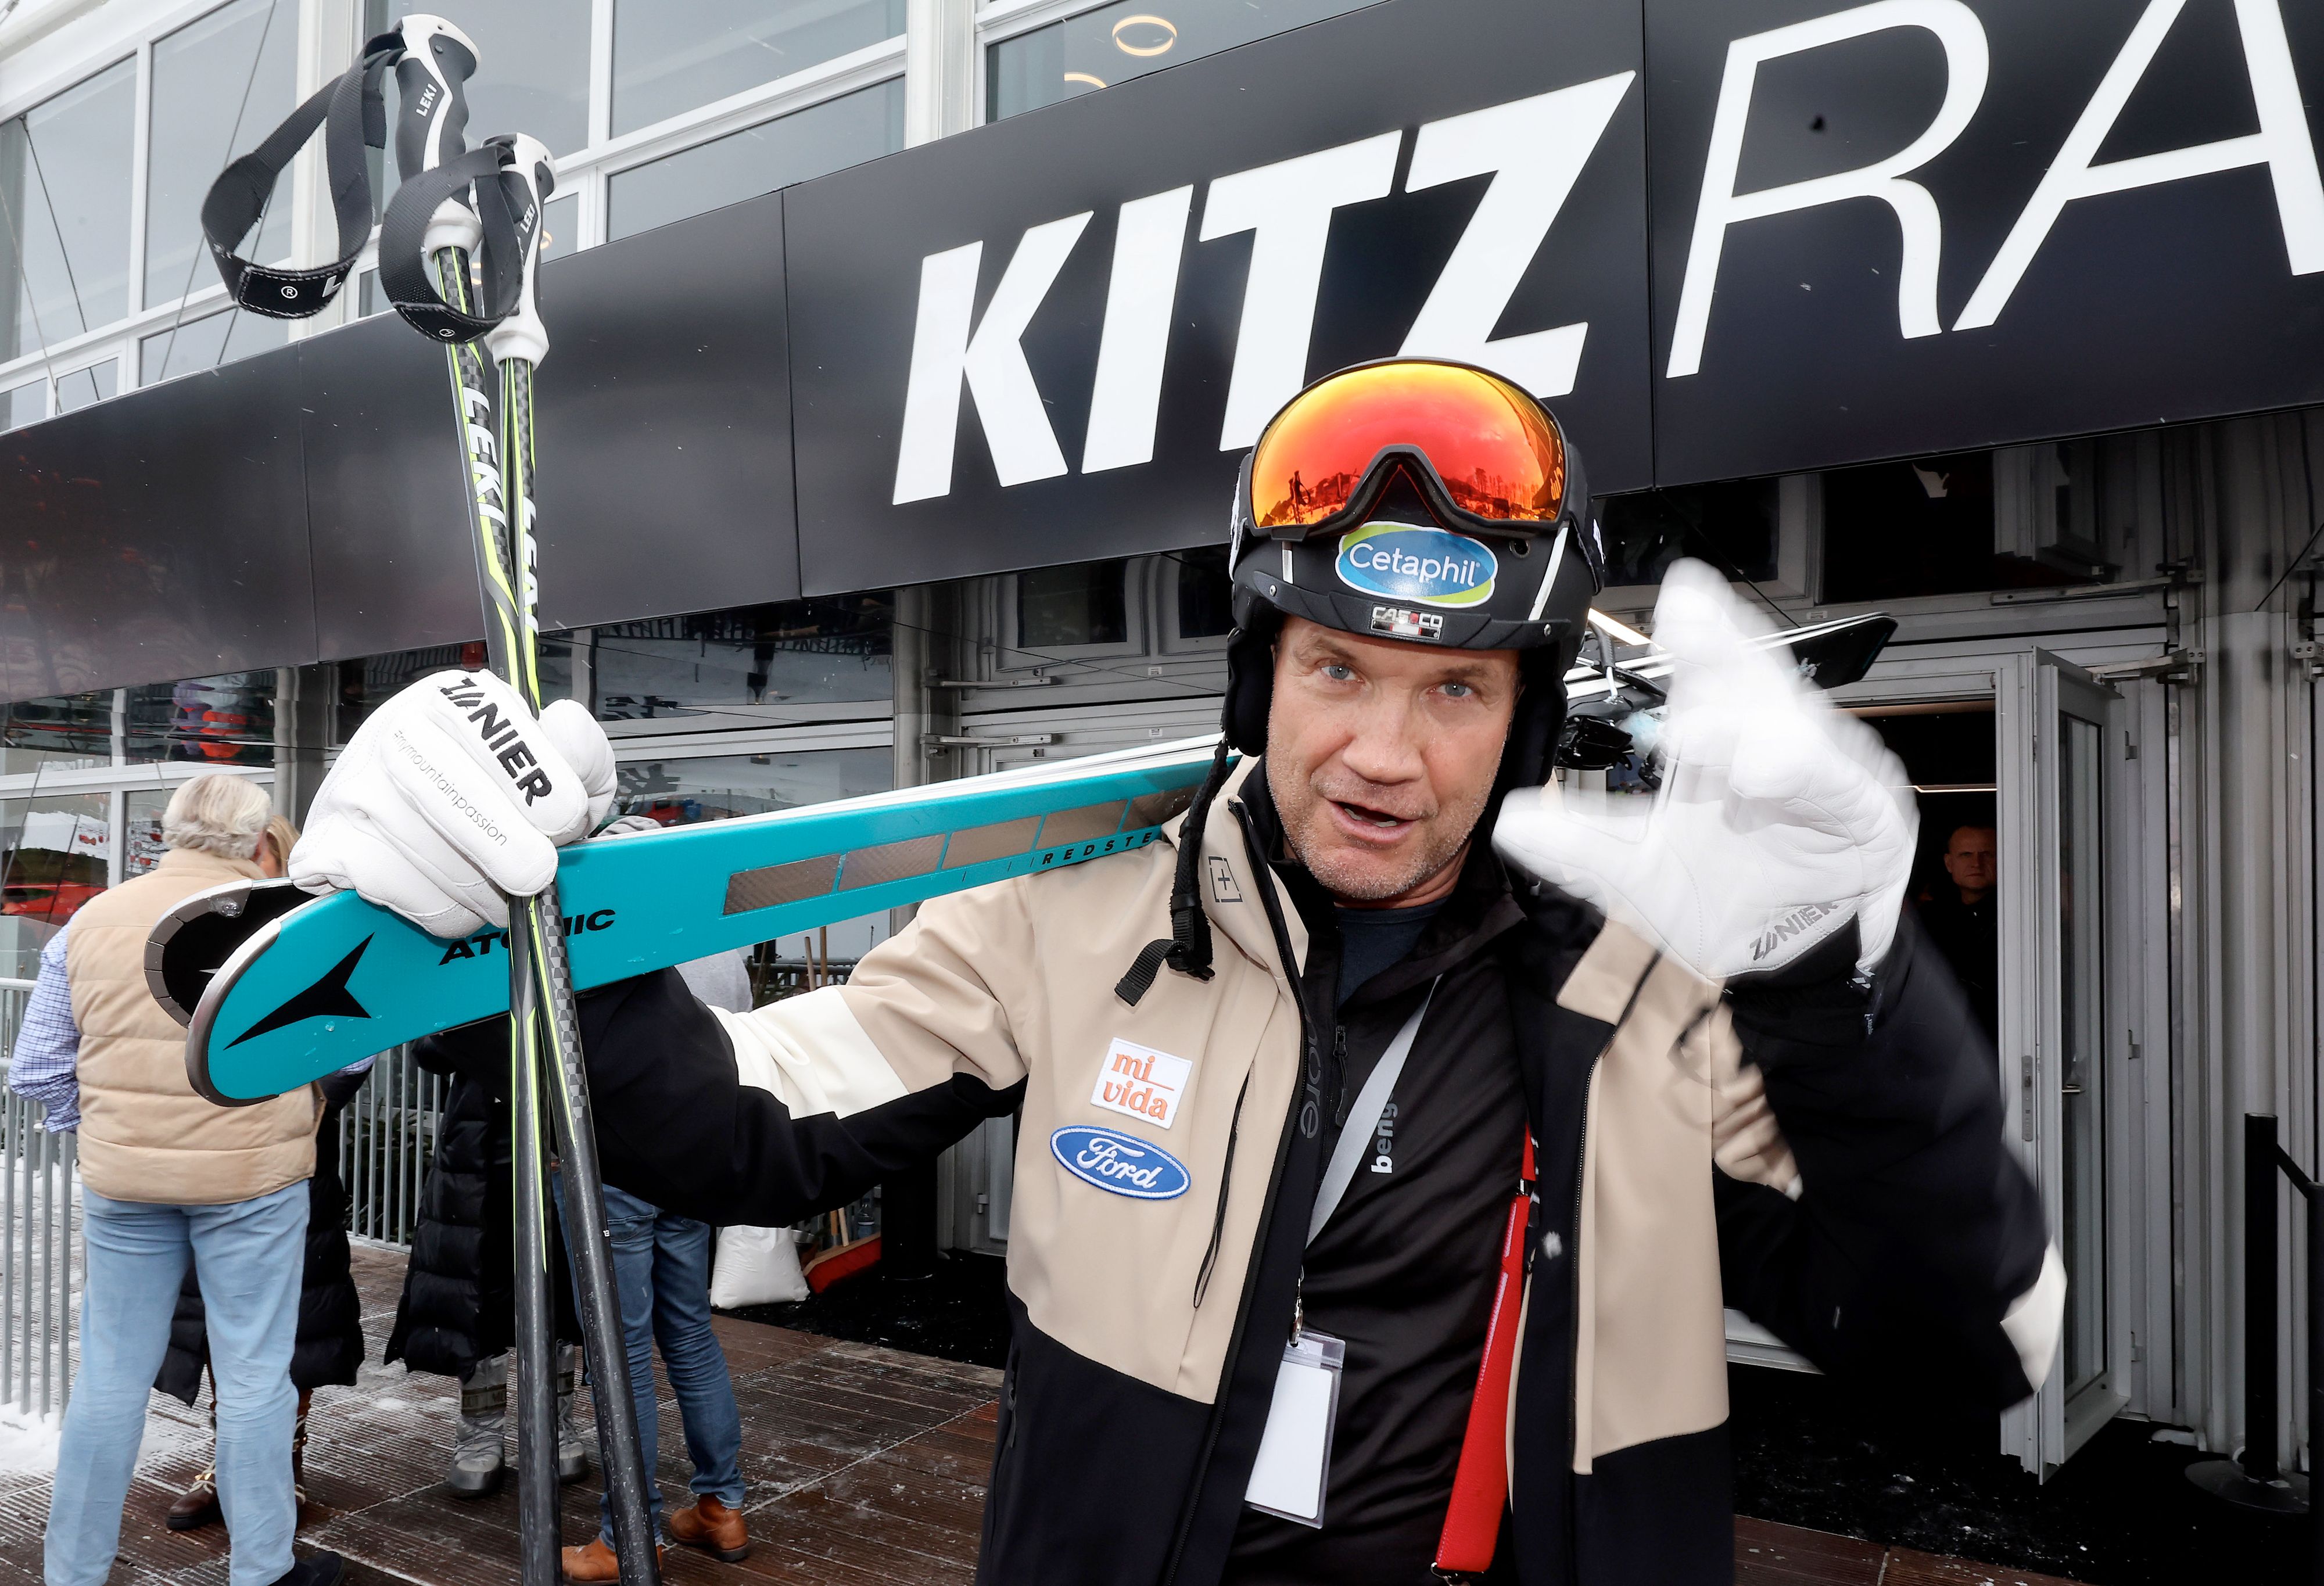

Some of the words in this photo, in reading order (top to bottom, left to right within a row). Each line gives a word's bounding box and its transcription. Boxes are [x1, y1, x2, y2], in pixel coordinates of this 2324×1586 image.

[415, 83, 437, 117] LEKI
[519, 203, 535, 234] LEKI
[892, 70, 1637, 505] KITZ
[462, 386, 507, 529] LEKI
[1349, 542, 1476, 587] Cetaphil
[440, 677, 552, 808] ZANIER
[392, 730, 507, 846] #mymountainpassion
[438, 909, 616, 966] ATIC
[1111, 1053, 1156, 1082] mi
[1103, 1080, 1168, 1121] vida
[1371, 1092, 1398, 1174] beng
[1076, 1137, 1163, 1189] Ford
